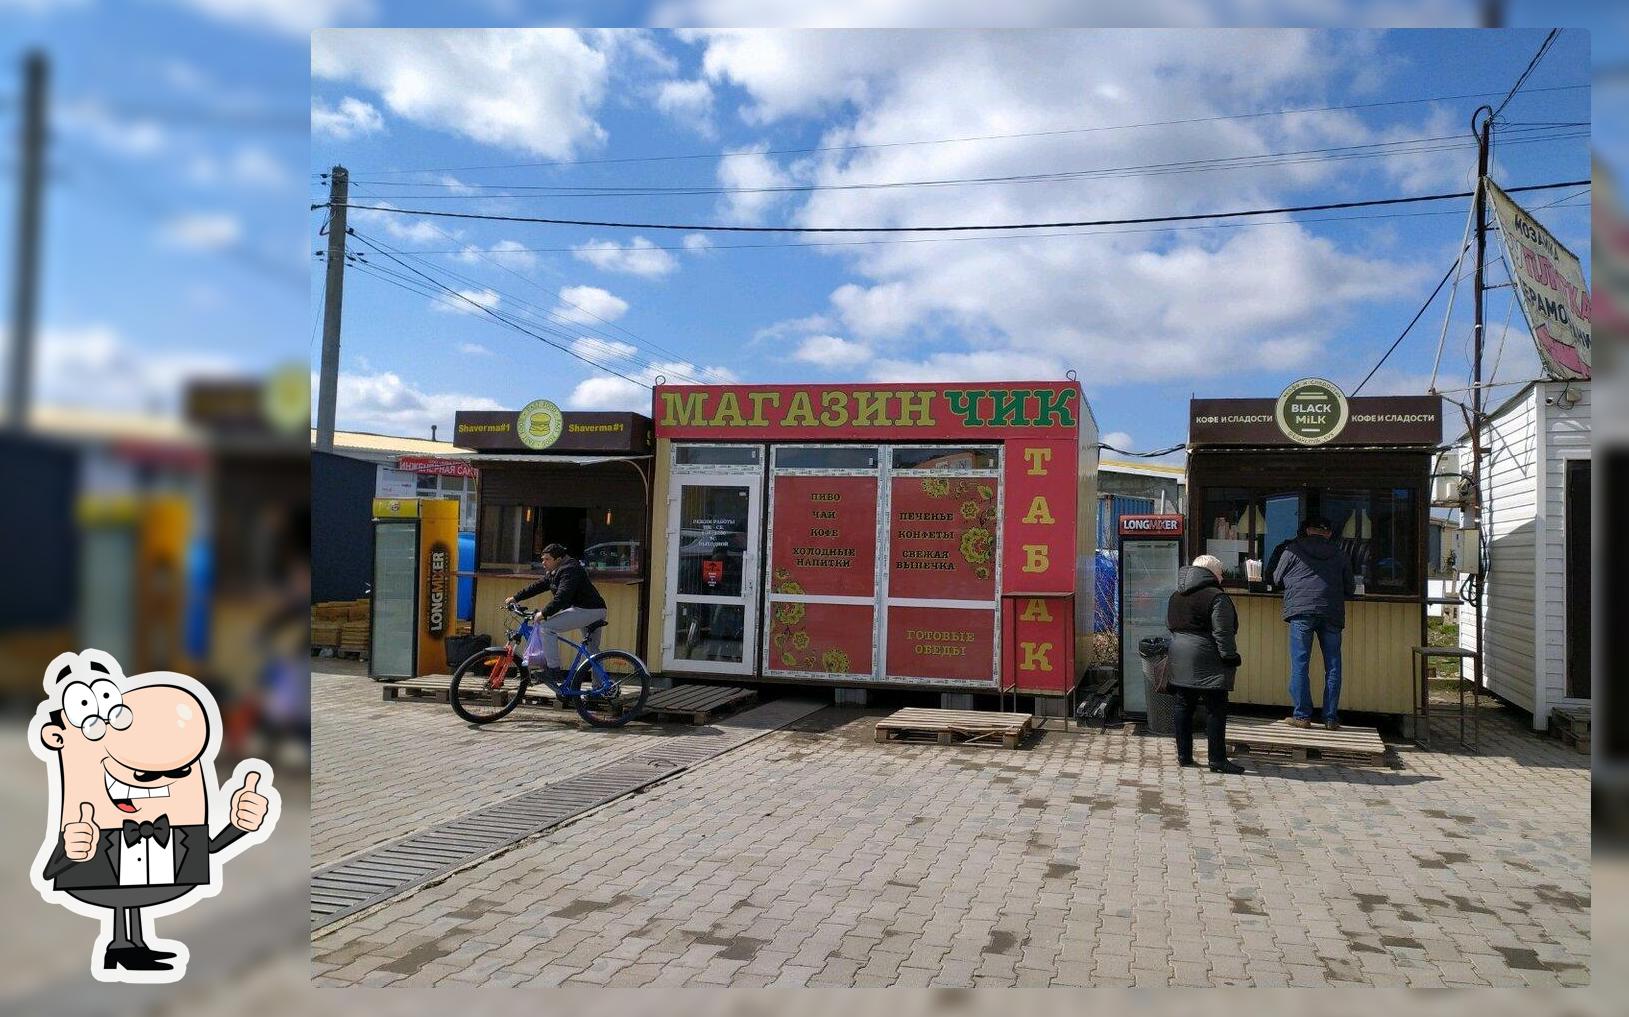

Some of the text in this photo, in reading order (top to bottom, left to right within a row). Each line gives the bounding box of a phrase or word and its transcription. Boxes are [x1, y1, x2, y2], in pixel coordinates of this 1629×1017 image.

[660, 388, 1078, 428] МАГАЗИН ЧИК
[1291, 403, 1332, 413] BLACK
[1196, 416, 1219, 424] КОФЕ
[1228, 415, 1273, 424] СЛАДОСТИ
[1351, 414, 1377, 423] КОФЕ
[1385, 414, 1435, 423] СЛАДОСТИ
[458, 423, 510, 433] Shaverma#1
[568, 423, 624, 433] Shaverma#1
[811, 493, 840, 502] ПИВО
[899, 512, 954, 522] ПЕЧЕНЬЕ
[810, 528, 839, 537] КОФЕ
[898, 530, 954, 540] КОНФЕТЫ
[793, 547, 856, 557] ХОЛОДНЫЕ
[902, 550, 950, 559] СВЕЖАЯ
[796, 558, 850, 568] НАПИТКИ
[1020, 447, 1055, 671] ТАБАК
[896, 561, 956, 571] ВЫПЕЧКА
[906, 630, 976, 642] ГОТОВЫЕ
[914, 644, 967, 656] ОБЕДЫ
